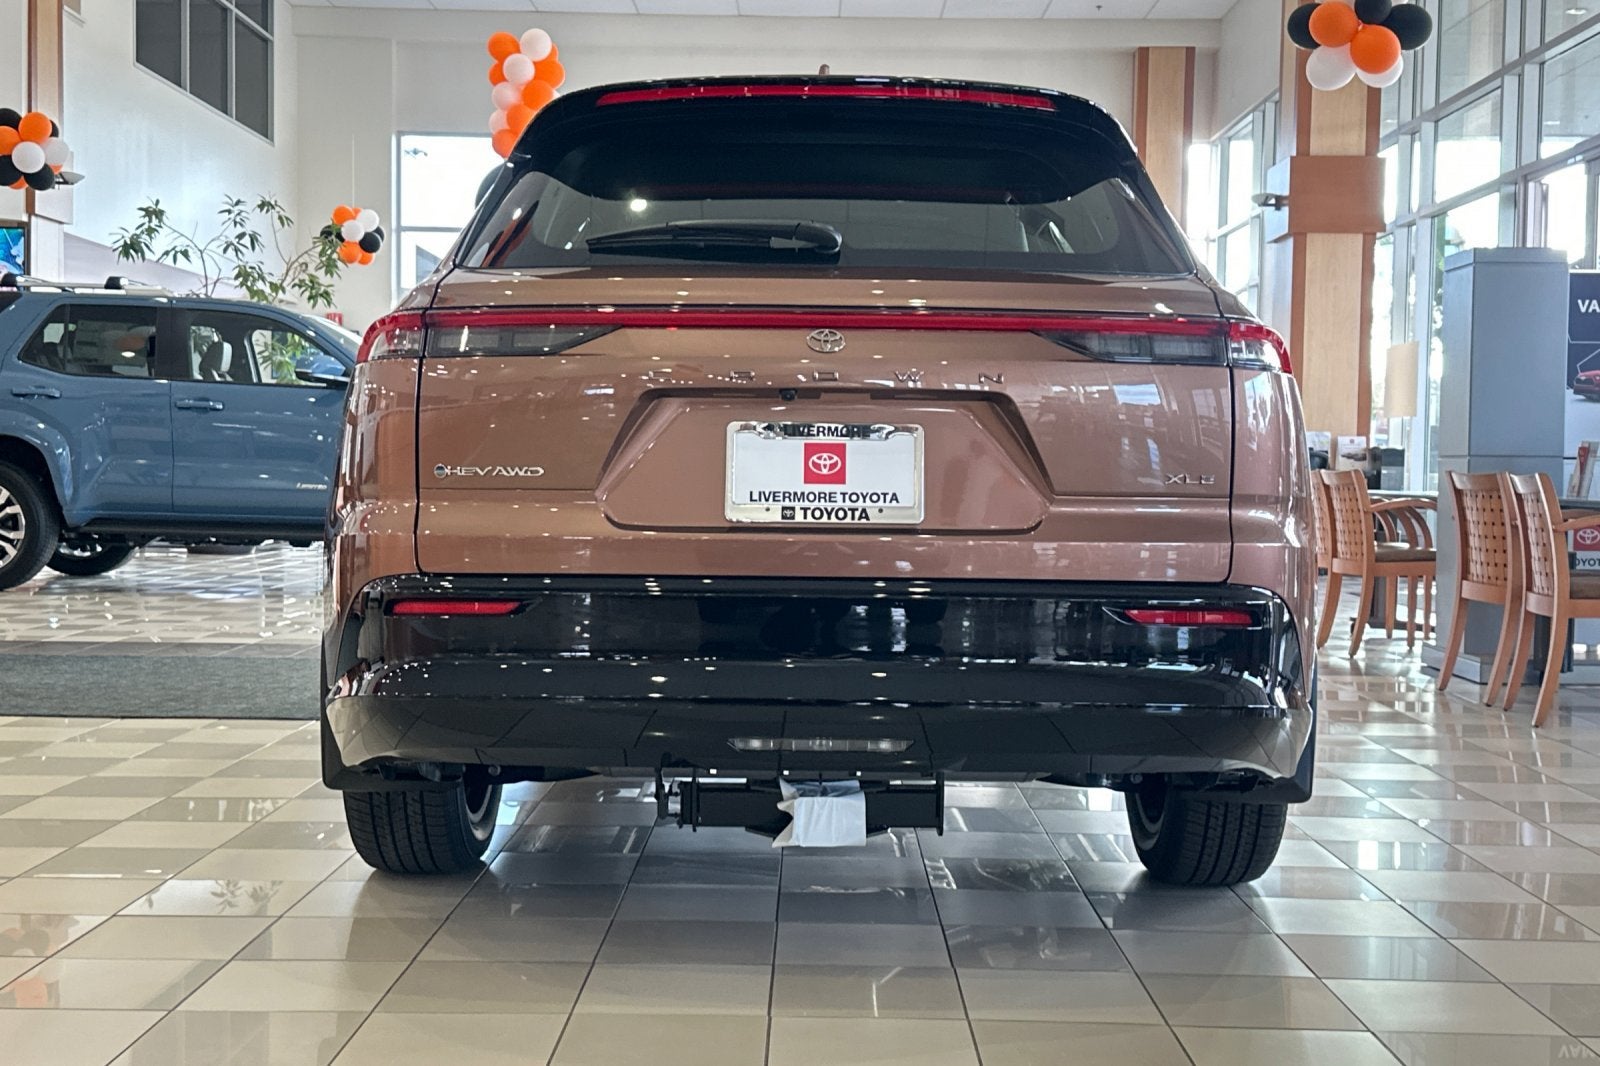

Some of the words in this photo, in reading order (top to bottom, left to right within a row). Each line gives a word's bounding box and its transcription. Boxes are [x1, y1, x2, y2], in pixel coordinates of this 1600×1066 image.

[492, 465, 545, 477] AWD
[749, 491, 838, 503] LIVERMORE
[840, 492, 900, 504] TOYOTA
[800, 507, 870, 521] TOYOTA
